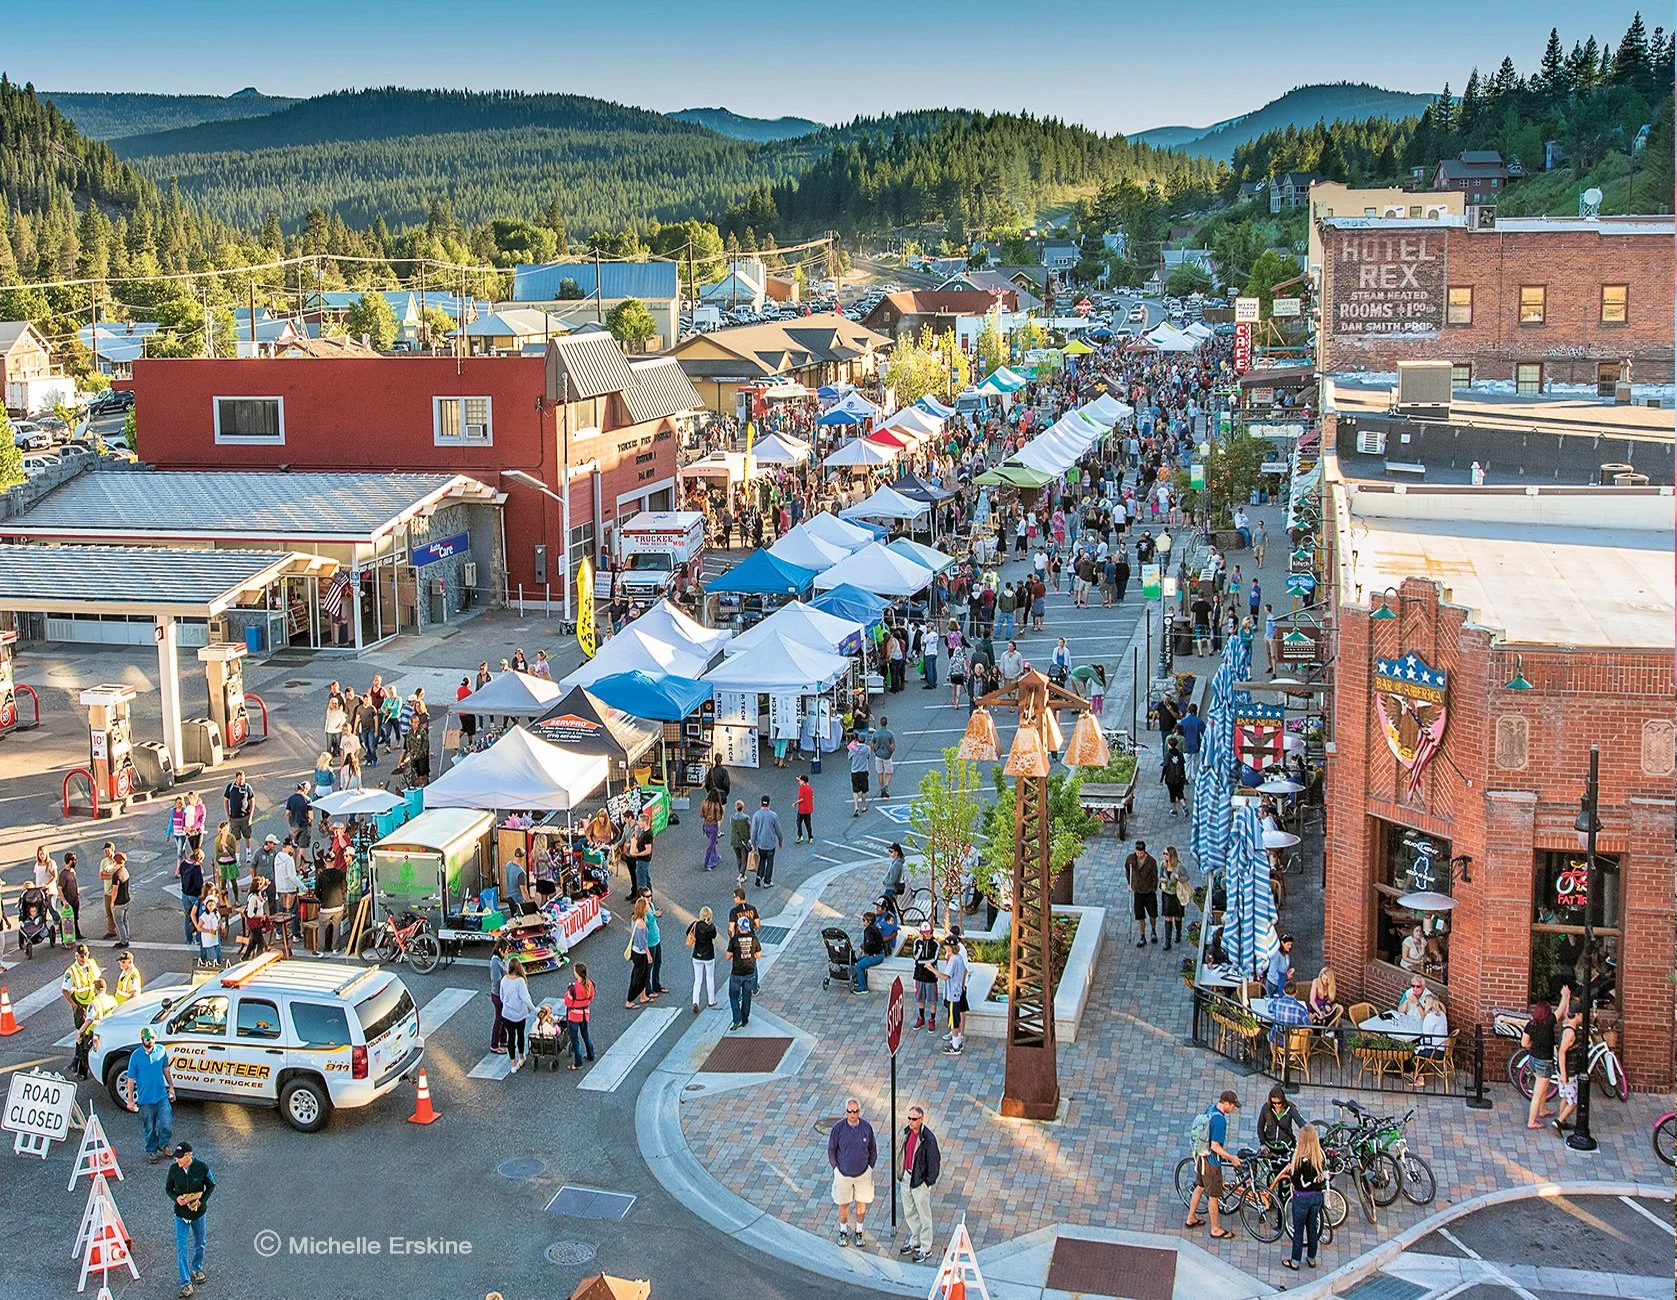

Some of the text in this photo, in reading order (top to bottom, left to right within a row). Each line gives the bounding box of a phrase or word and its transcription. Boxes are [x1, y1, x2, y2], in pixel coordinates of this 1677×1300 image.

[1342, 236, 1436, 261] HOTEL
[1360, 263, 1420, 288] REX
[1341, 304, 1393, 317] ROOMS
[1236, 325, 1246, 369] CAFE
[634, 535, 674, 543] TRUCKEE
[429, 542, 441, 554] Auto
[439, 545, 453, 559] Care
[1376, 677, 1392, 692] BAR
[1404, 684, 1443, 703] AMERICA
[550, 719, 587, 728] SERVPRO
[1256, 719, 1282, 727] AMERICA
[1420, 844, 1439, 855] LIGHT
[1557, 894, 1575, 905] FAT
[888, 993, 903, 1038] STOP
[367, 1030, 392, 1048] VOLUNTEER
[174, 1047, 207, 1055] POLICE
[325, 1063, 350, 1072] 911
[172, 1073, 200, 1082] TOWN
[219, 1078, 264, 1088] TRUCKEE
[22, 1083, 61, 1105] ROAD
[10, 1105, 63, 1130] CLOSED
